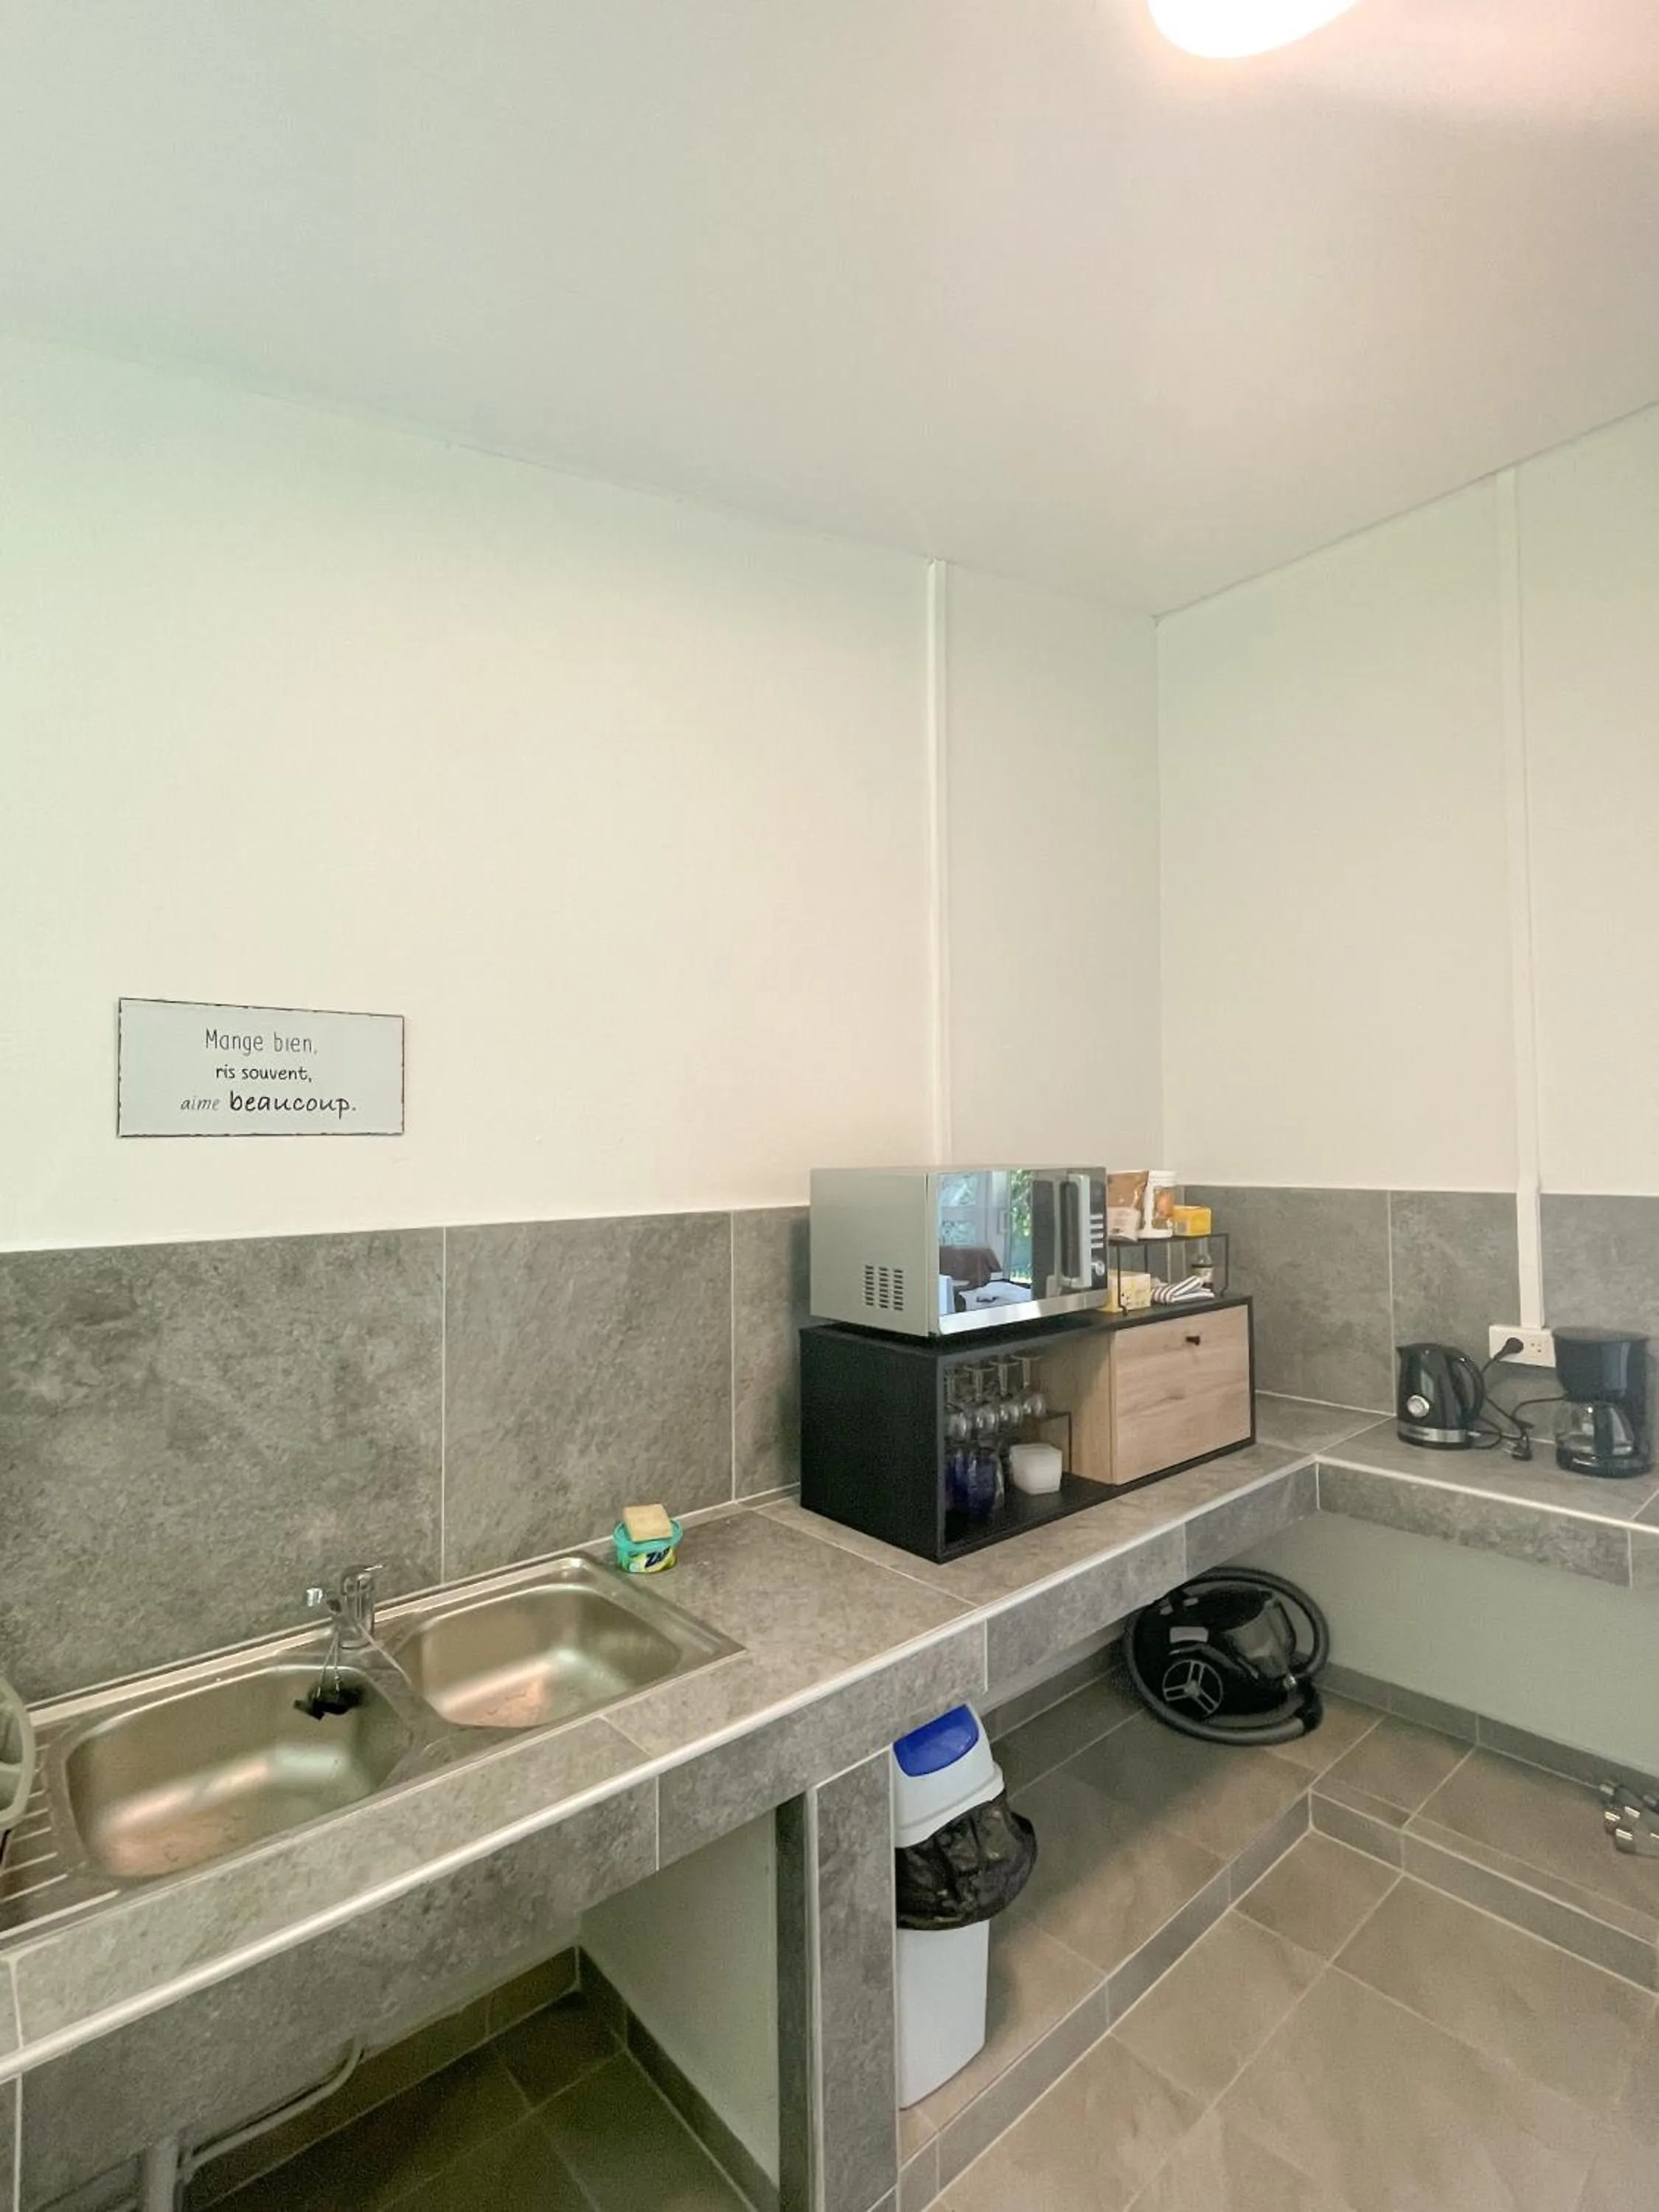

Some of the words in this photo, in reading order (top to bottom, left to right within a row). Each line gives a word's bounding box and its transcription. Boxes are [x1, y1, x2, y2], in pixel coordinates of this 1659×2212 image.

[206, 1028, 263, 1056] Mange
[215, 1064, 236, 1079] ris
[241, 1066, 312, 1082] souvent,
[180, 1095, 221, 1110] aime
[229, 1090, 356, 1119] beaucoup.
